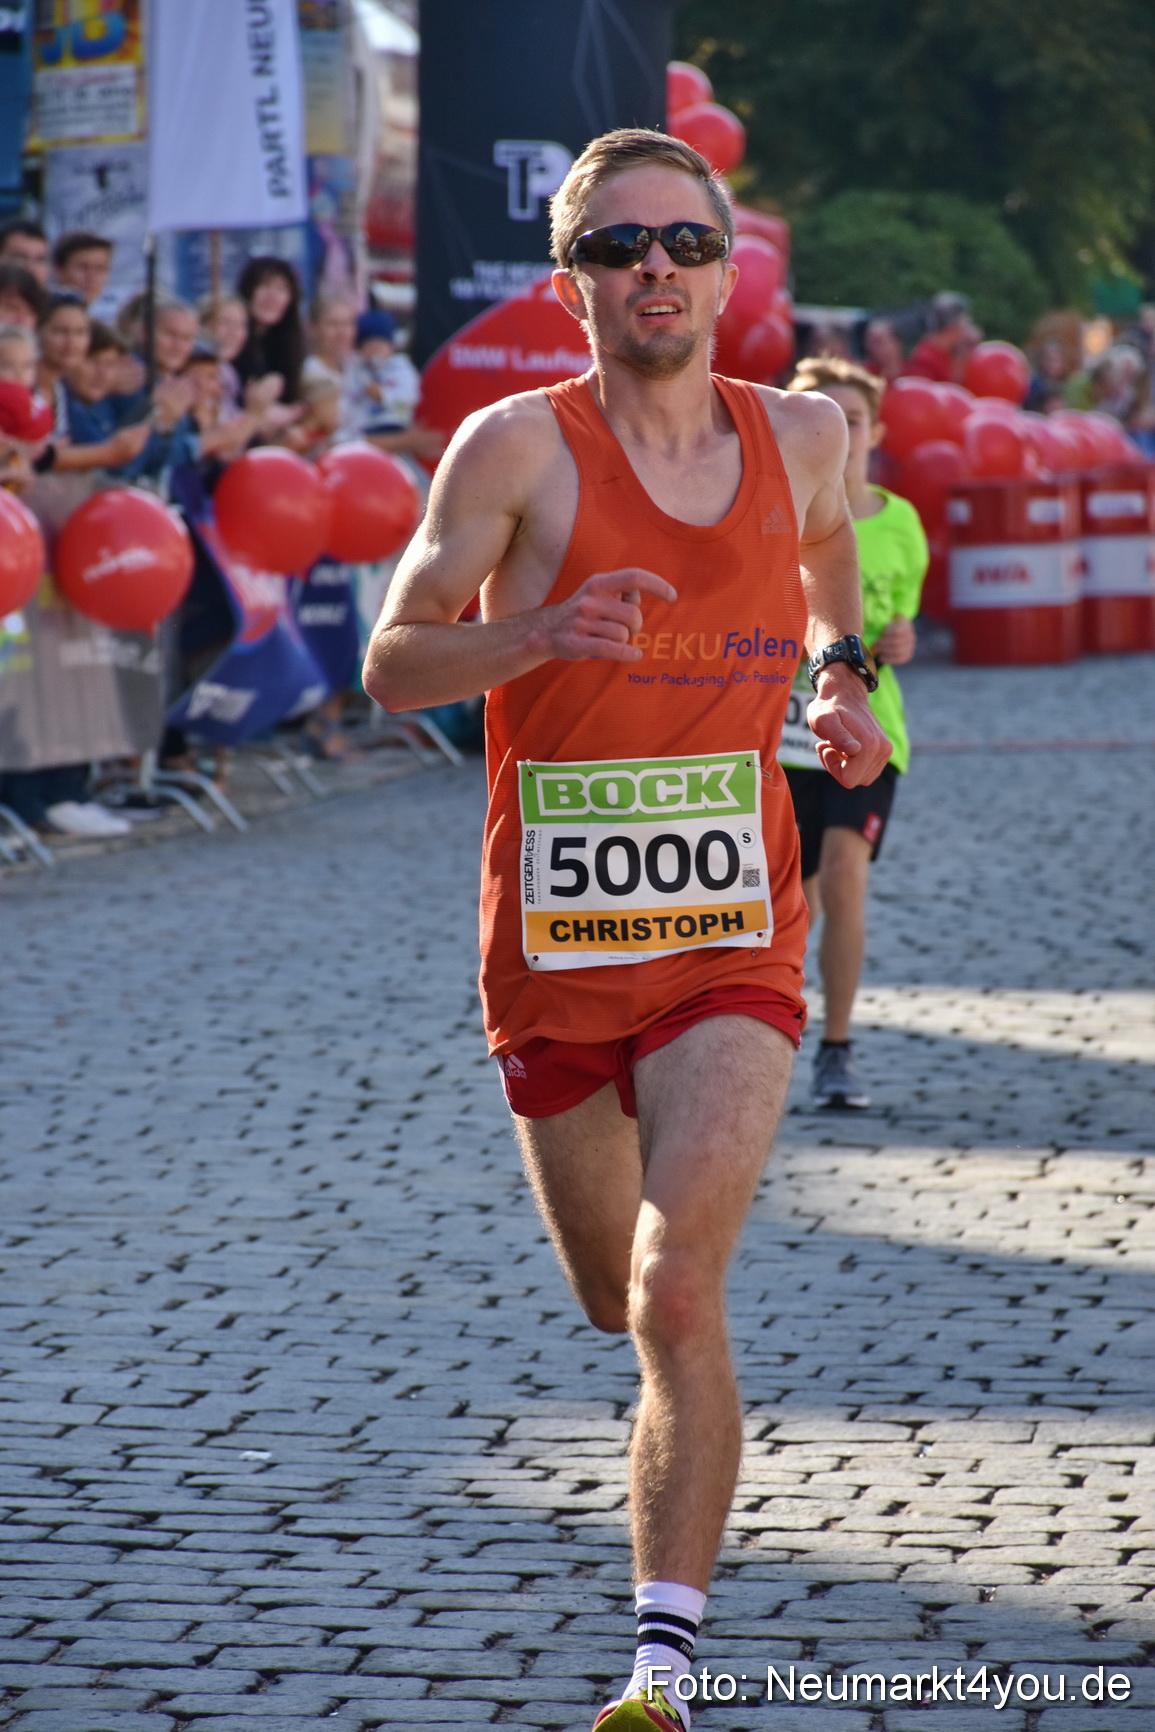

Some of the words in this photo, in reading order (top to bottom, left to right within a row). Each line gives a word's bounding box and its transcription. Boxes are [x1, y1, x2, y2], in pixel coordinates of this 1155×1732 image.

[246, 0, 275, 77] NEU
[257, 84, 291, 198] PARTL
[631, 627, 798, 661] PEKUFolen
[627, 673, 656, 685] Your
[753, 671, 790, 684] Passio
[537, 763, 740, 816] BOCK
[742, 832, 752, 844] S
[550, 830, 740, 898] 5000
[550, 911, 745, 942] CHRISTOPH
